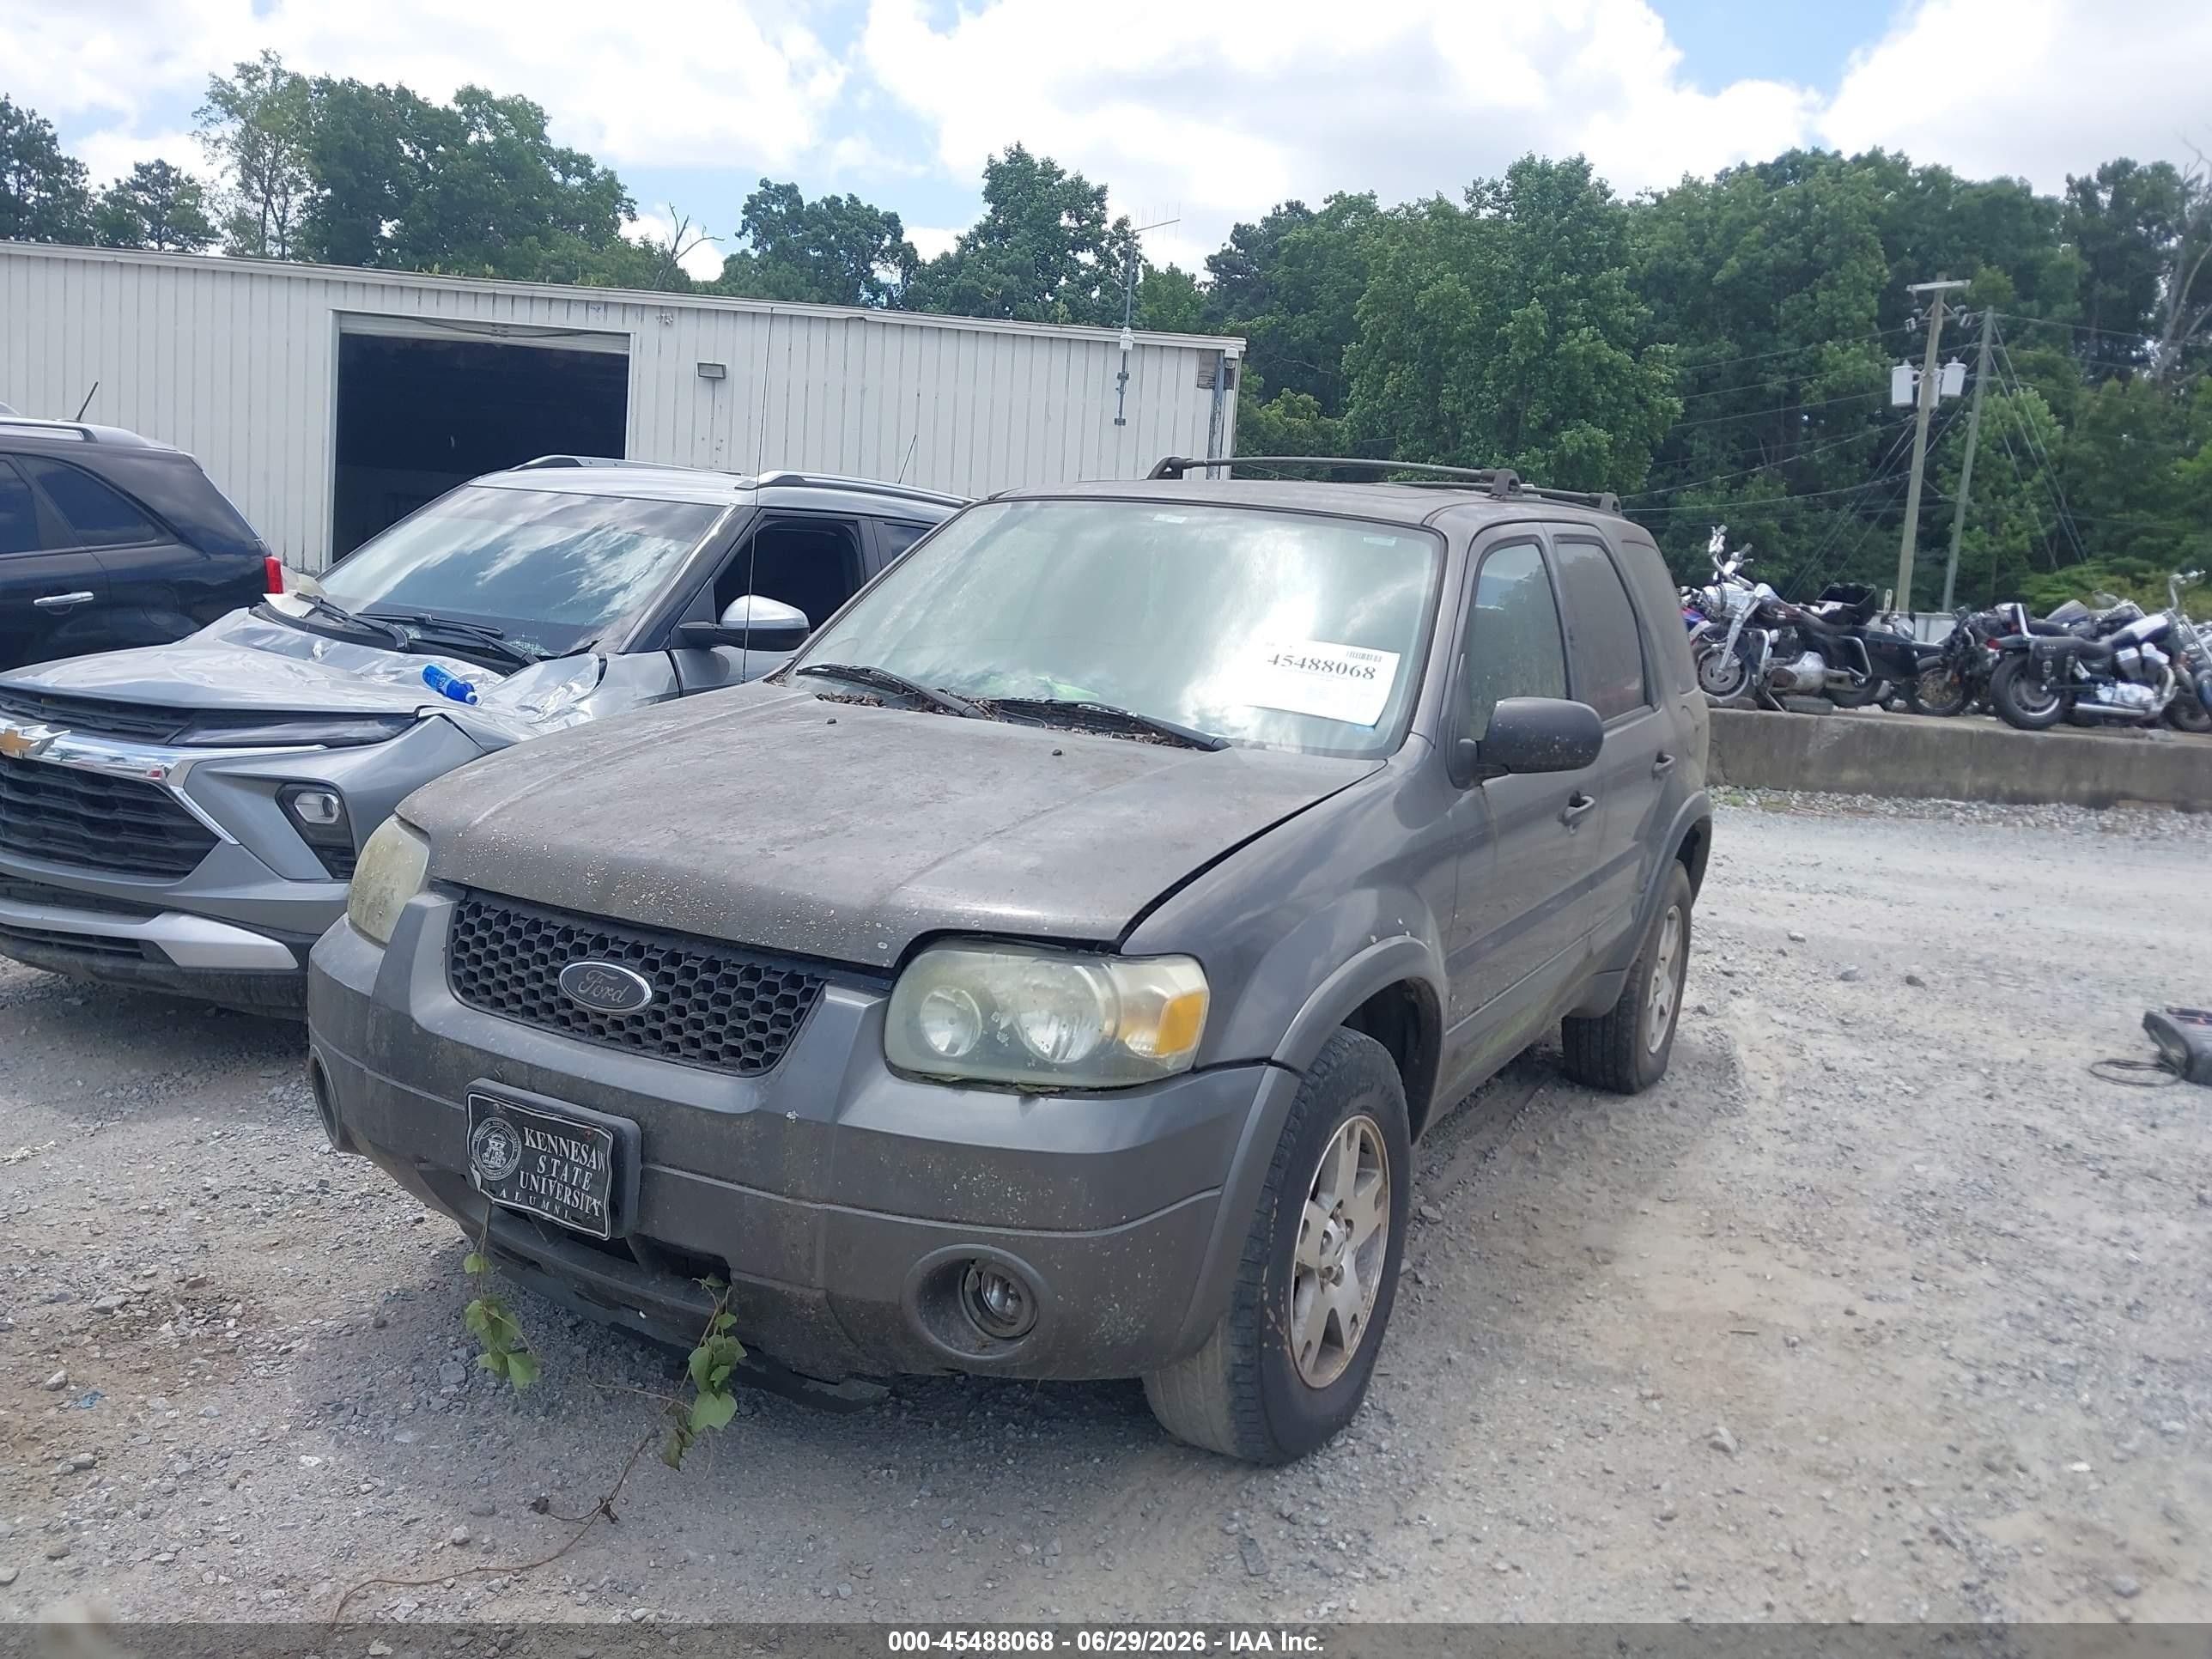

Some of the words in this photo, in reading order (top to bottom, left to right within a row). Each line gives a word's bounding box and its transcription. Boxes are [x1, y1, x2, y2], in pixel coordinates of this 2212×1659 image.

[1267, 653, 1376, 680] 45488068
[578, 969, 630, 1003] Ford
[523, 1127, 606, 1174] KENNESAW
[537, 1155, 592, 1191] STATE
[519, 1170, 602, 1217] UNIVERSITY
